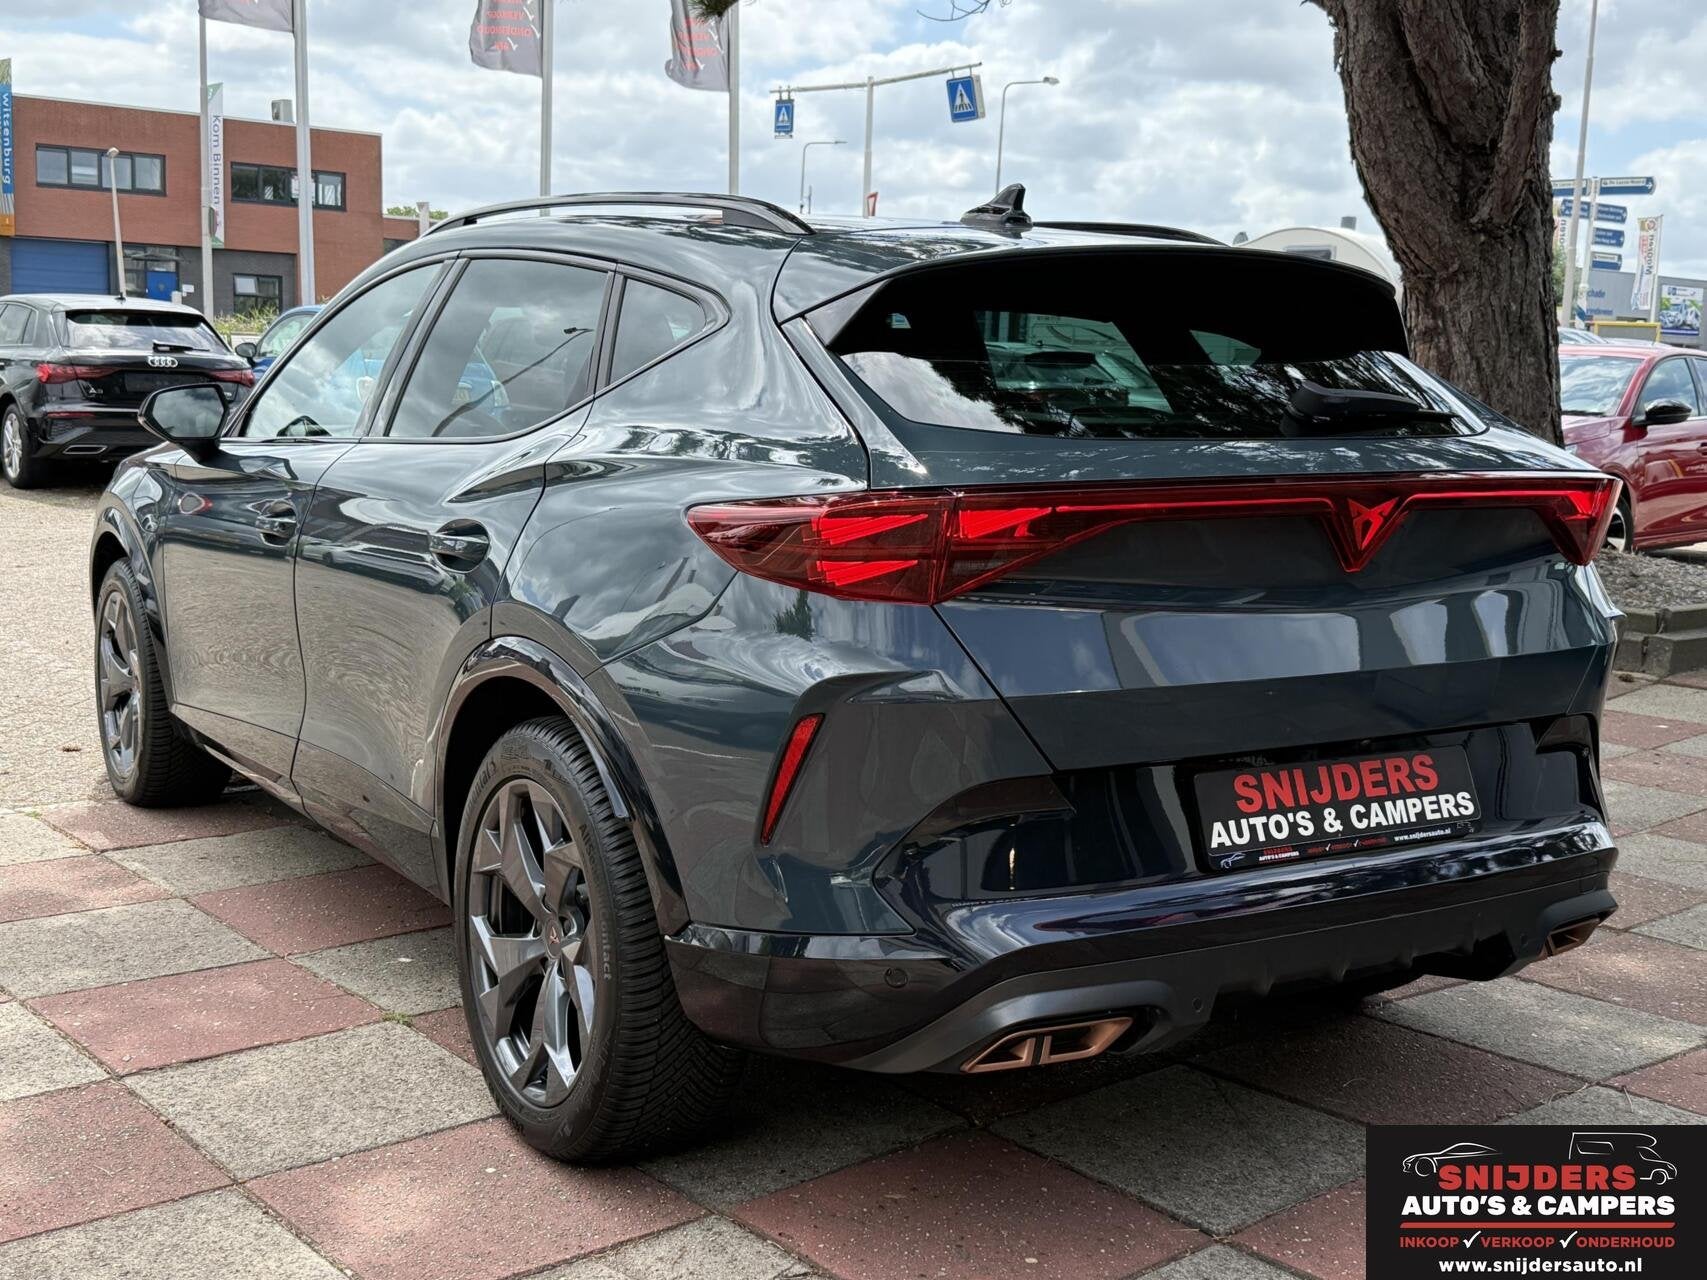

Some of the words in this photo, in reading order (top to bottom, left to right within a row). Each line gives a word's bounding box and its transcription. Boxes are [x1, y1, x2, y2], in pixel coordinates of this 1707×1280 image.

[212, 115, 222, 148] Kom
[212, 153, 222, 205] Binnen
[1233, 754, 1439, 813] SNIJDERS
[1210, 808, 1315, 849] AUTO'S
[1323, 807, 1344, 833] &
[1350, 791, 1475, 829] CAMPERS
